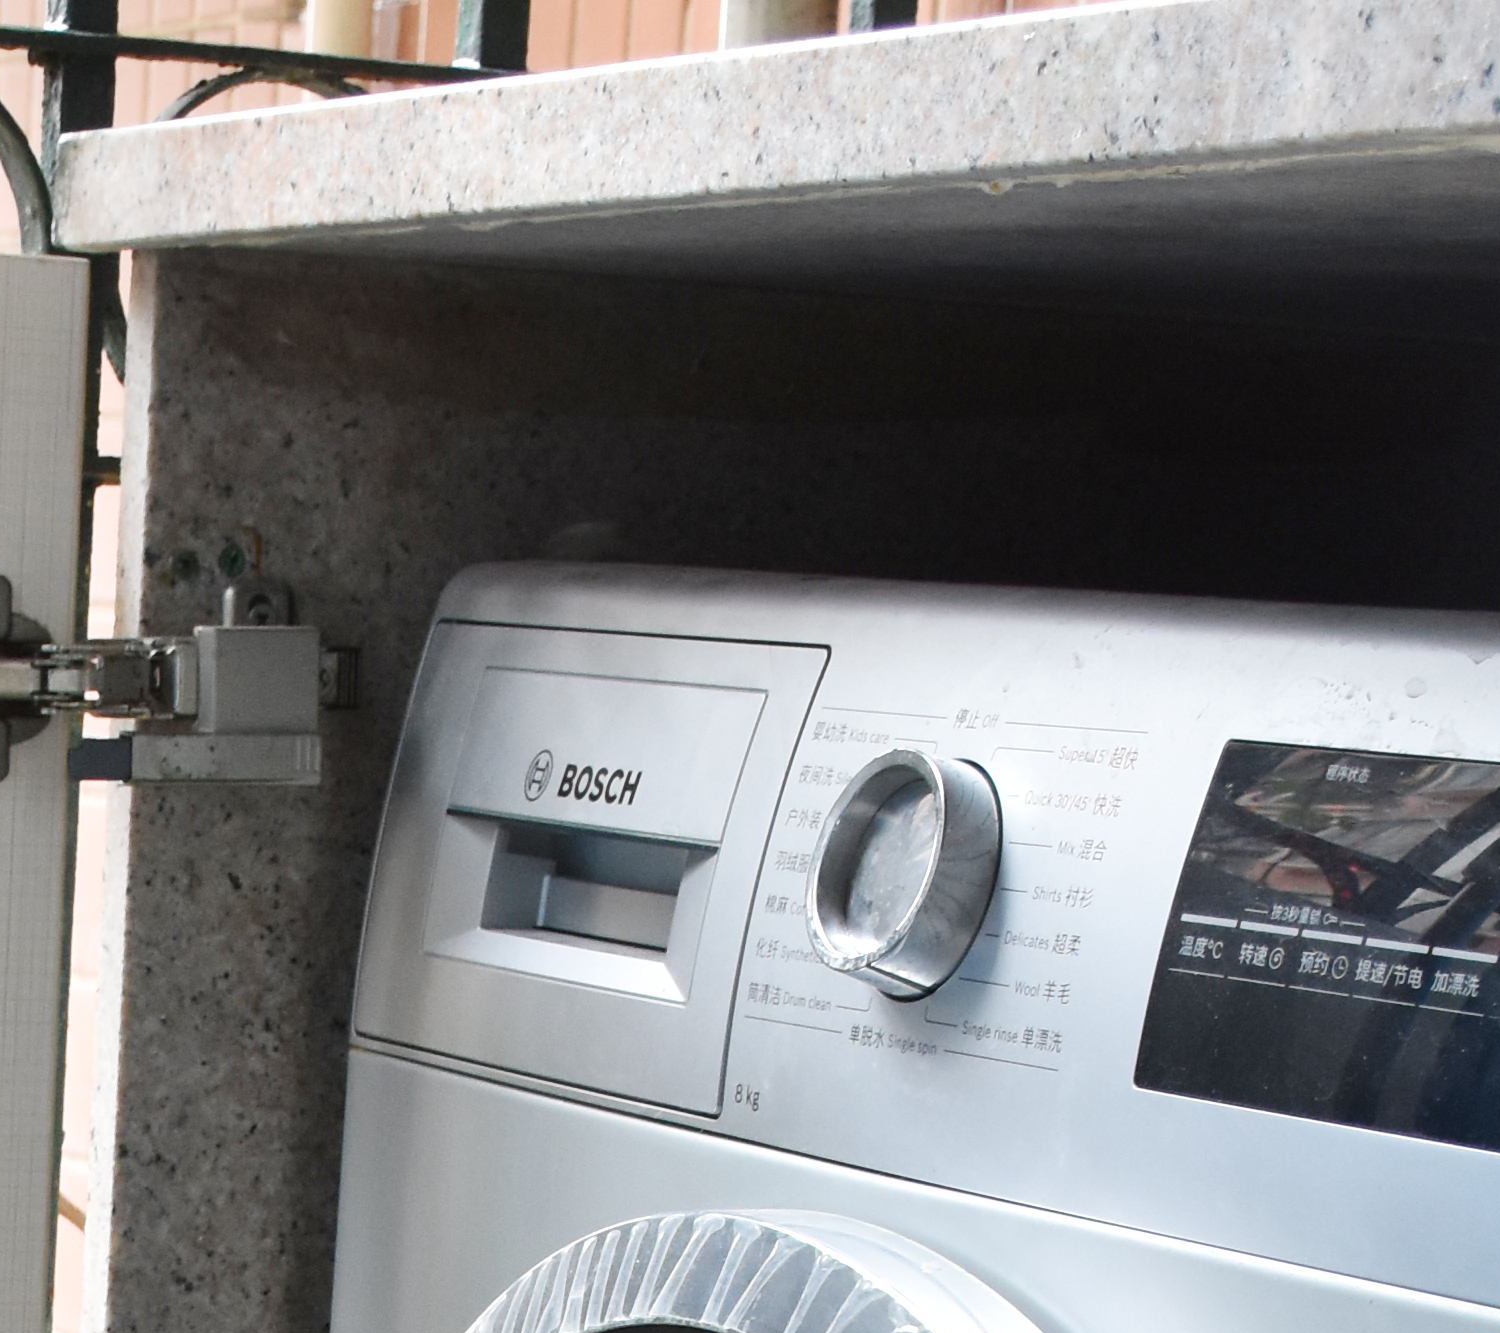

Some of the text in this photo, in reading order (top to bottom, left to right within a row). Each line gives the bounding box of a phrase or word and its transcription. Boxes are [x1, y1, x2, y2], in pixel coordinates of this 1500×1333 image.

[982, 714, 1000, 728] Off
[849, 728, 868, 742] Kids
[869, 733, 890, 745] care
[557, 763, 643, 806] BOSCH
[1025, 790, 1053, 806] Quick
[1056, 841, 1075, 856] Mix
[1032, 886, 1062, 904] Shirts
[1004, 930, 1050, 951] Delicates
[1238, 942, 1269, 967] 转速
[1298, 950, 1330, 977] 预约
[1354, 959, 1424, 990] 提速/节电
[1430, 970, 1481, 998] 加漂洗
[783, 990, 807, 1007] Drum
[808, 994, 833, 1012] clean
[1014, 980, 1071, 1005] Wool 羊毛
[849, 1023, 937, 1057] 单脱水 Single spin
[961, 1020, 1063, 1053] Single rinse 单漂洗
[734, 1083, 760, 1112] 8 kg
